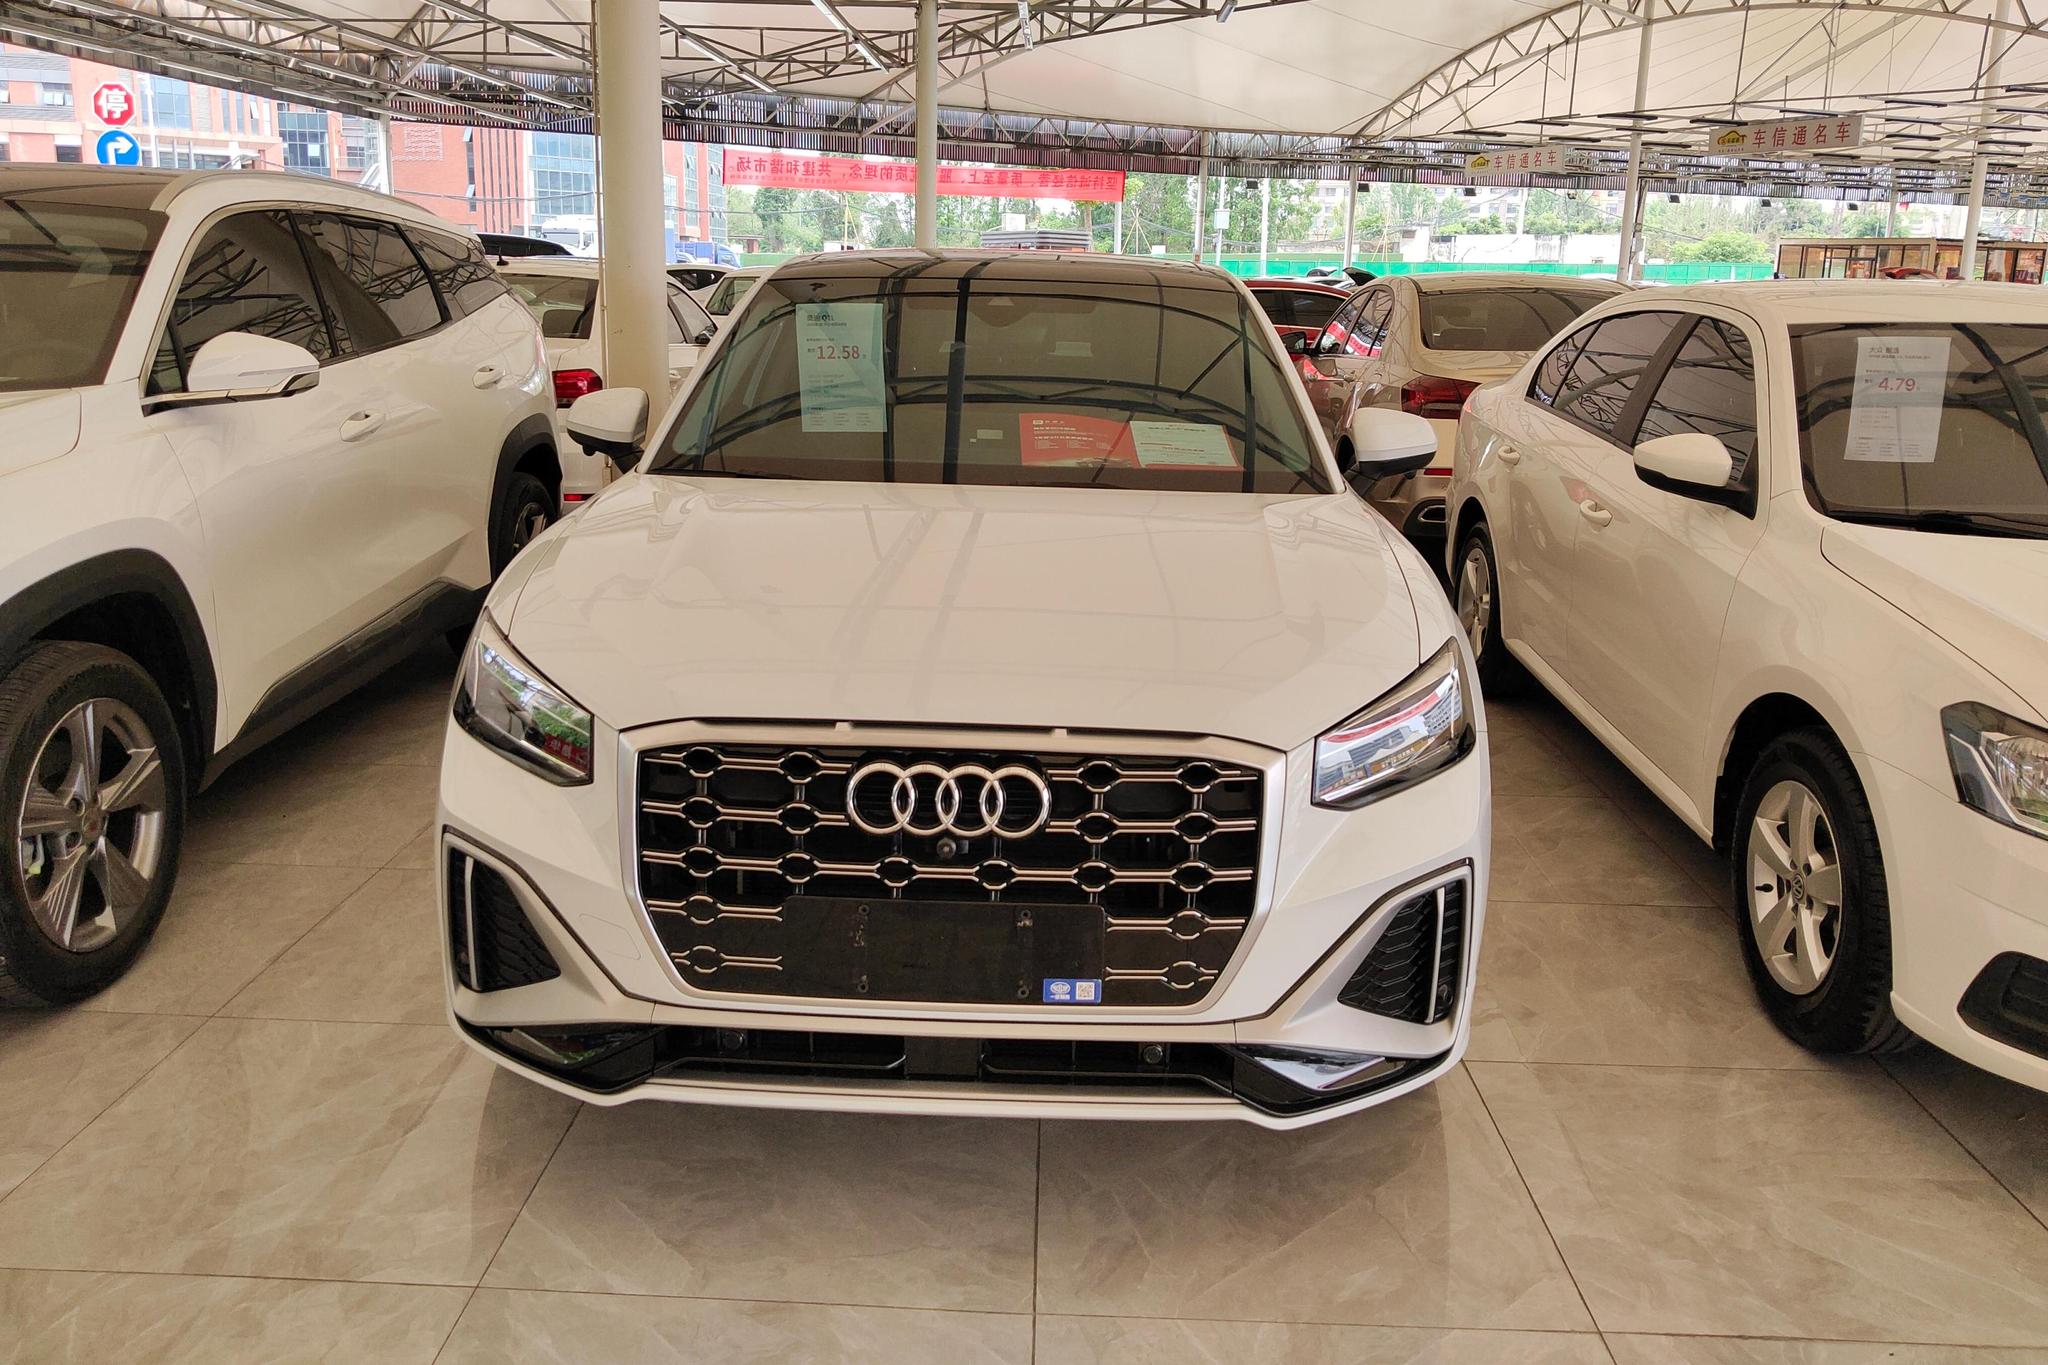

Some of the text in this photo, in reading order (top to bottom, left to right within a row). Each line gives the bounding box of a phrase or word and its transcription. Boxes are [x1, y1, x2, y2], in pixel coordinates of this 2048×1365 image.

[98, 87, 129, 119] 停
[1752, 121, 1851, 149] 车信通名车
[1494, 149, 1557, 171] 车信通名车
[817, 345, 860, 360] 12.58
[1878, 377, 1916, 392] 4.79
